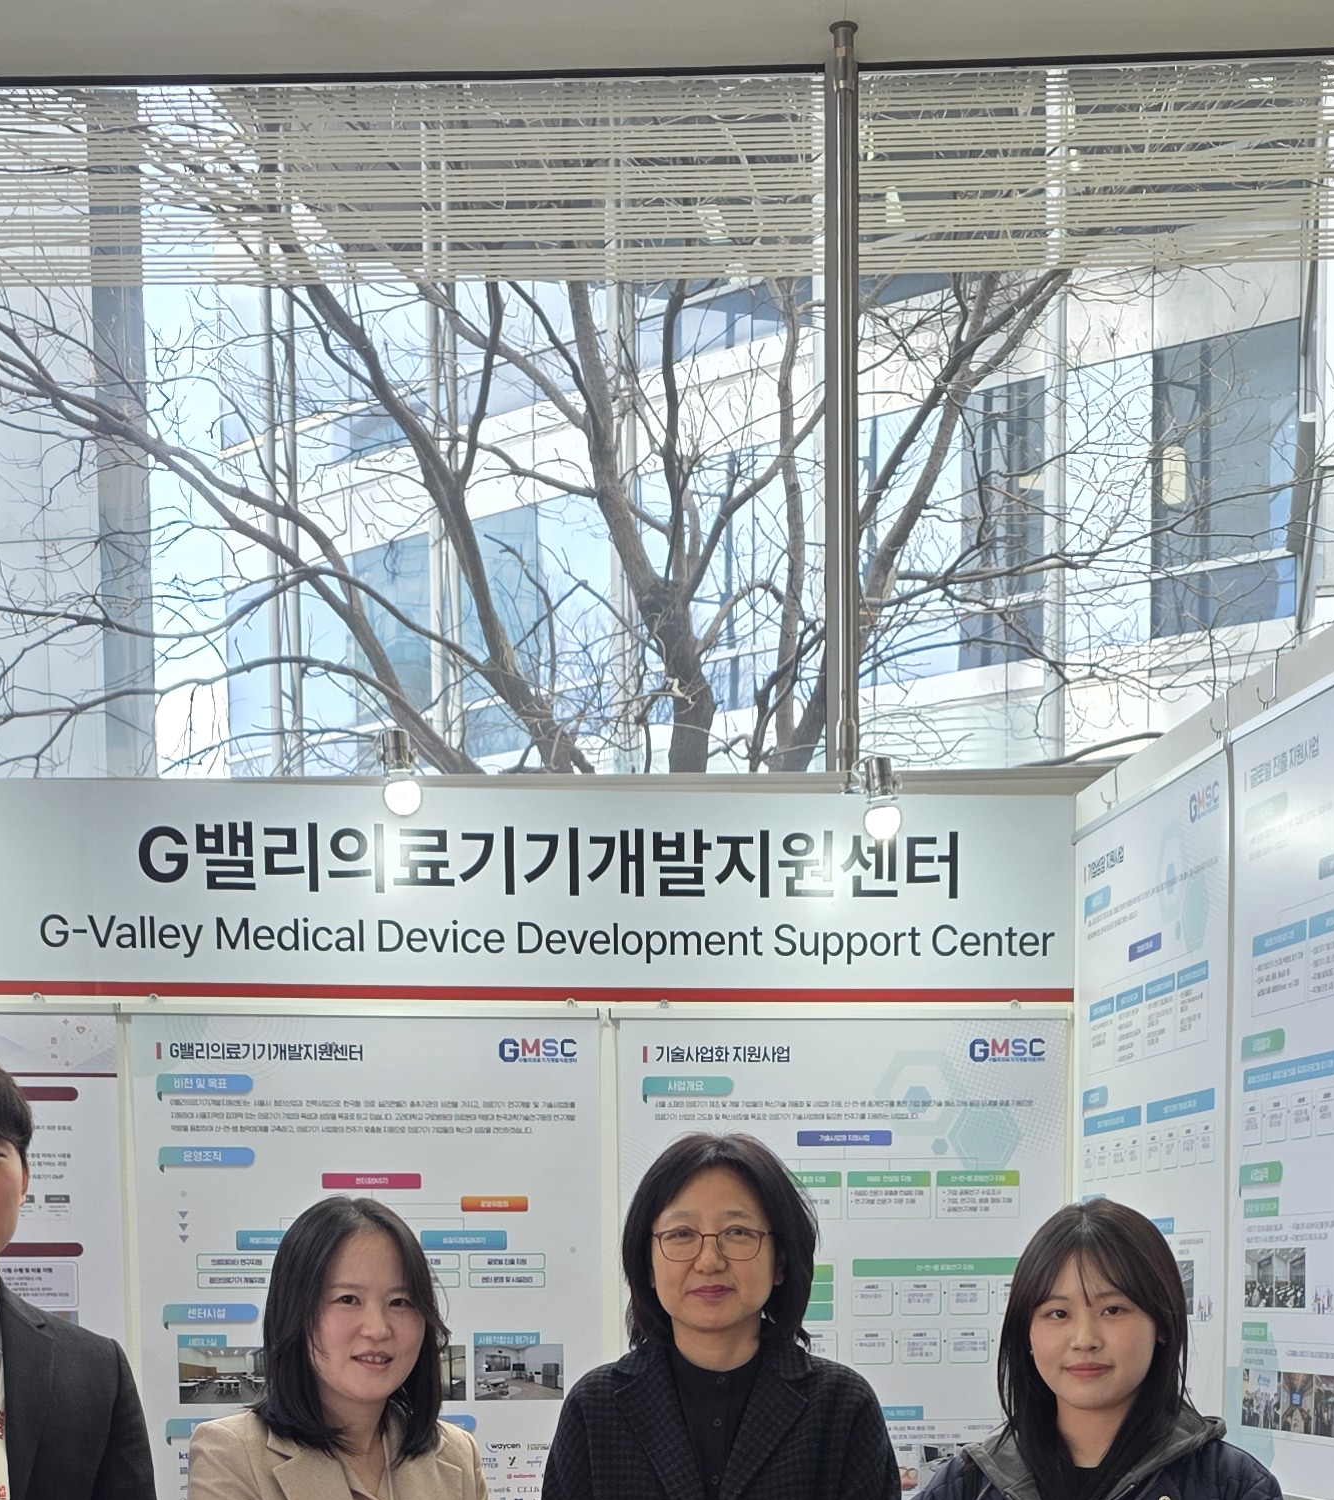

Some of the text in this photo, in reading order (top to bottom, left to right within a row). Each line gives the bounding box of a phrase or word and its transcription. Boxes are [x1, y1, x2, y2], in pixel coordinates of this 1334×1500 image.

[1189, 780, 1220, 824] GMSC
[138, 821, 959, 899] G밸리의료기기개발지원센터
[40, 913, 1056, 965] G-Valley Medical Device Development Support Center
[169, 1042, 363, 1062] G밸리의료기기개발지원센터
[499, 1038, 578, 1063] GMSC
[655, 1045, 791, 1063] 기술사업화 지원사업
[969, 1038, 1046, 1063] GMSC
[174, 1078, 227, 1089] 비전 및 목표
[667, 1080, 704, 1092] 사업개요
[183, 1151, 222, 1162] 운영조직
[188, 1307, 226, 1319] 센터시설
